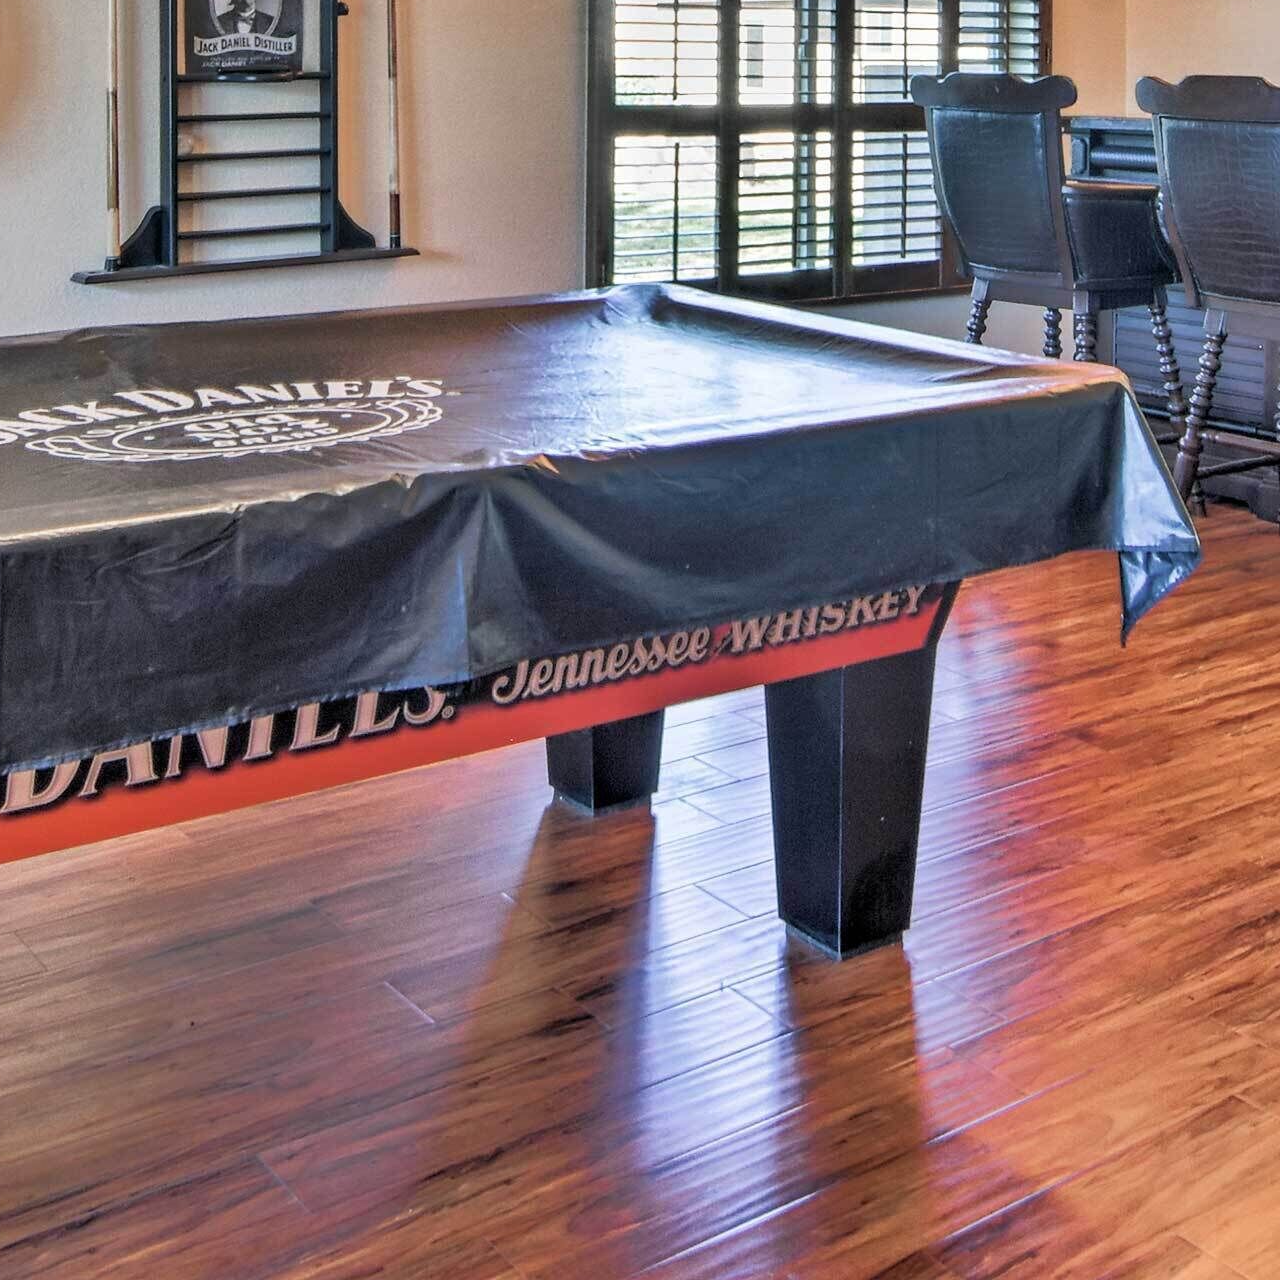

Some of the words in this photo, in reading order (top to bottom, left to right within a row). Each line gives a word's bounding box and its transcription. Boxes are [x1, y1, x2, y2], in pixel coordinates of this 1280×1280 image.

[198, 40, 218, 53] JACK
[221, 38, 250, 50] DANIEL
[254, 37, 293, 51] DISTILLER
[113, 376, 445, 414] DANIEL'S
[728, 584, 928, 654] WHISKEY
